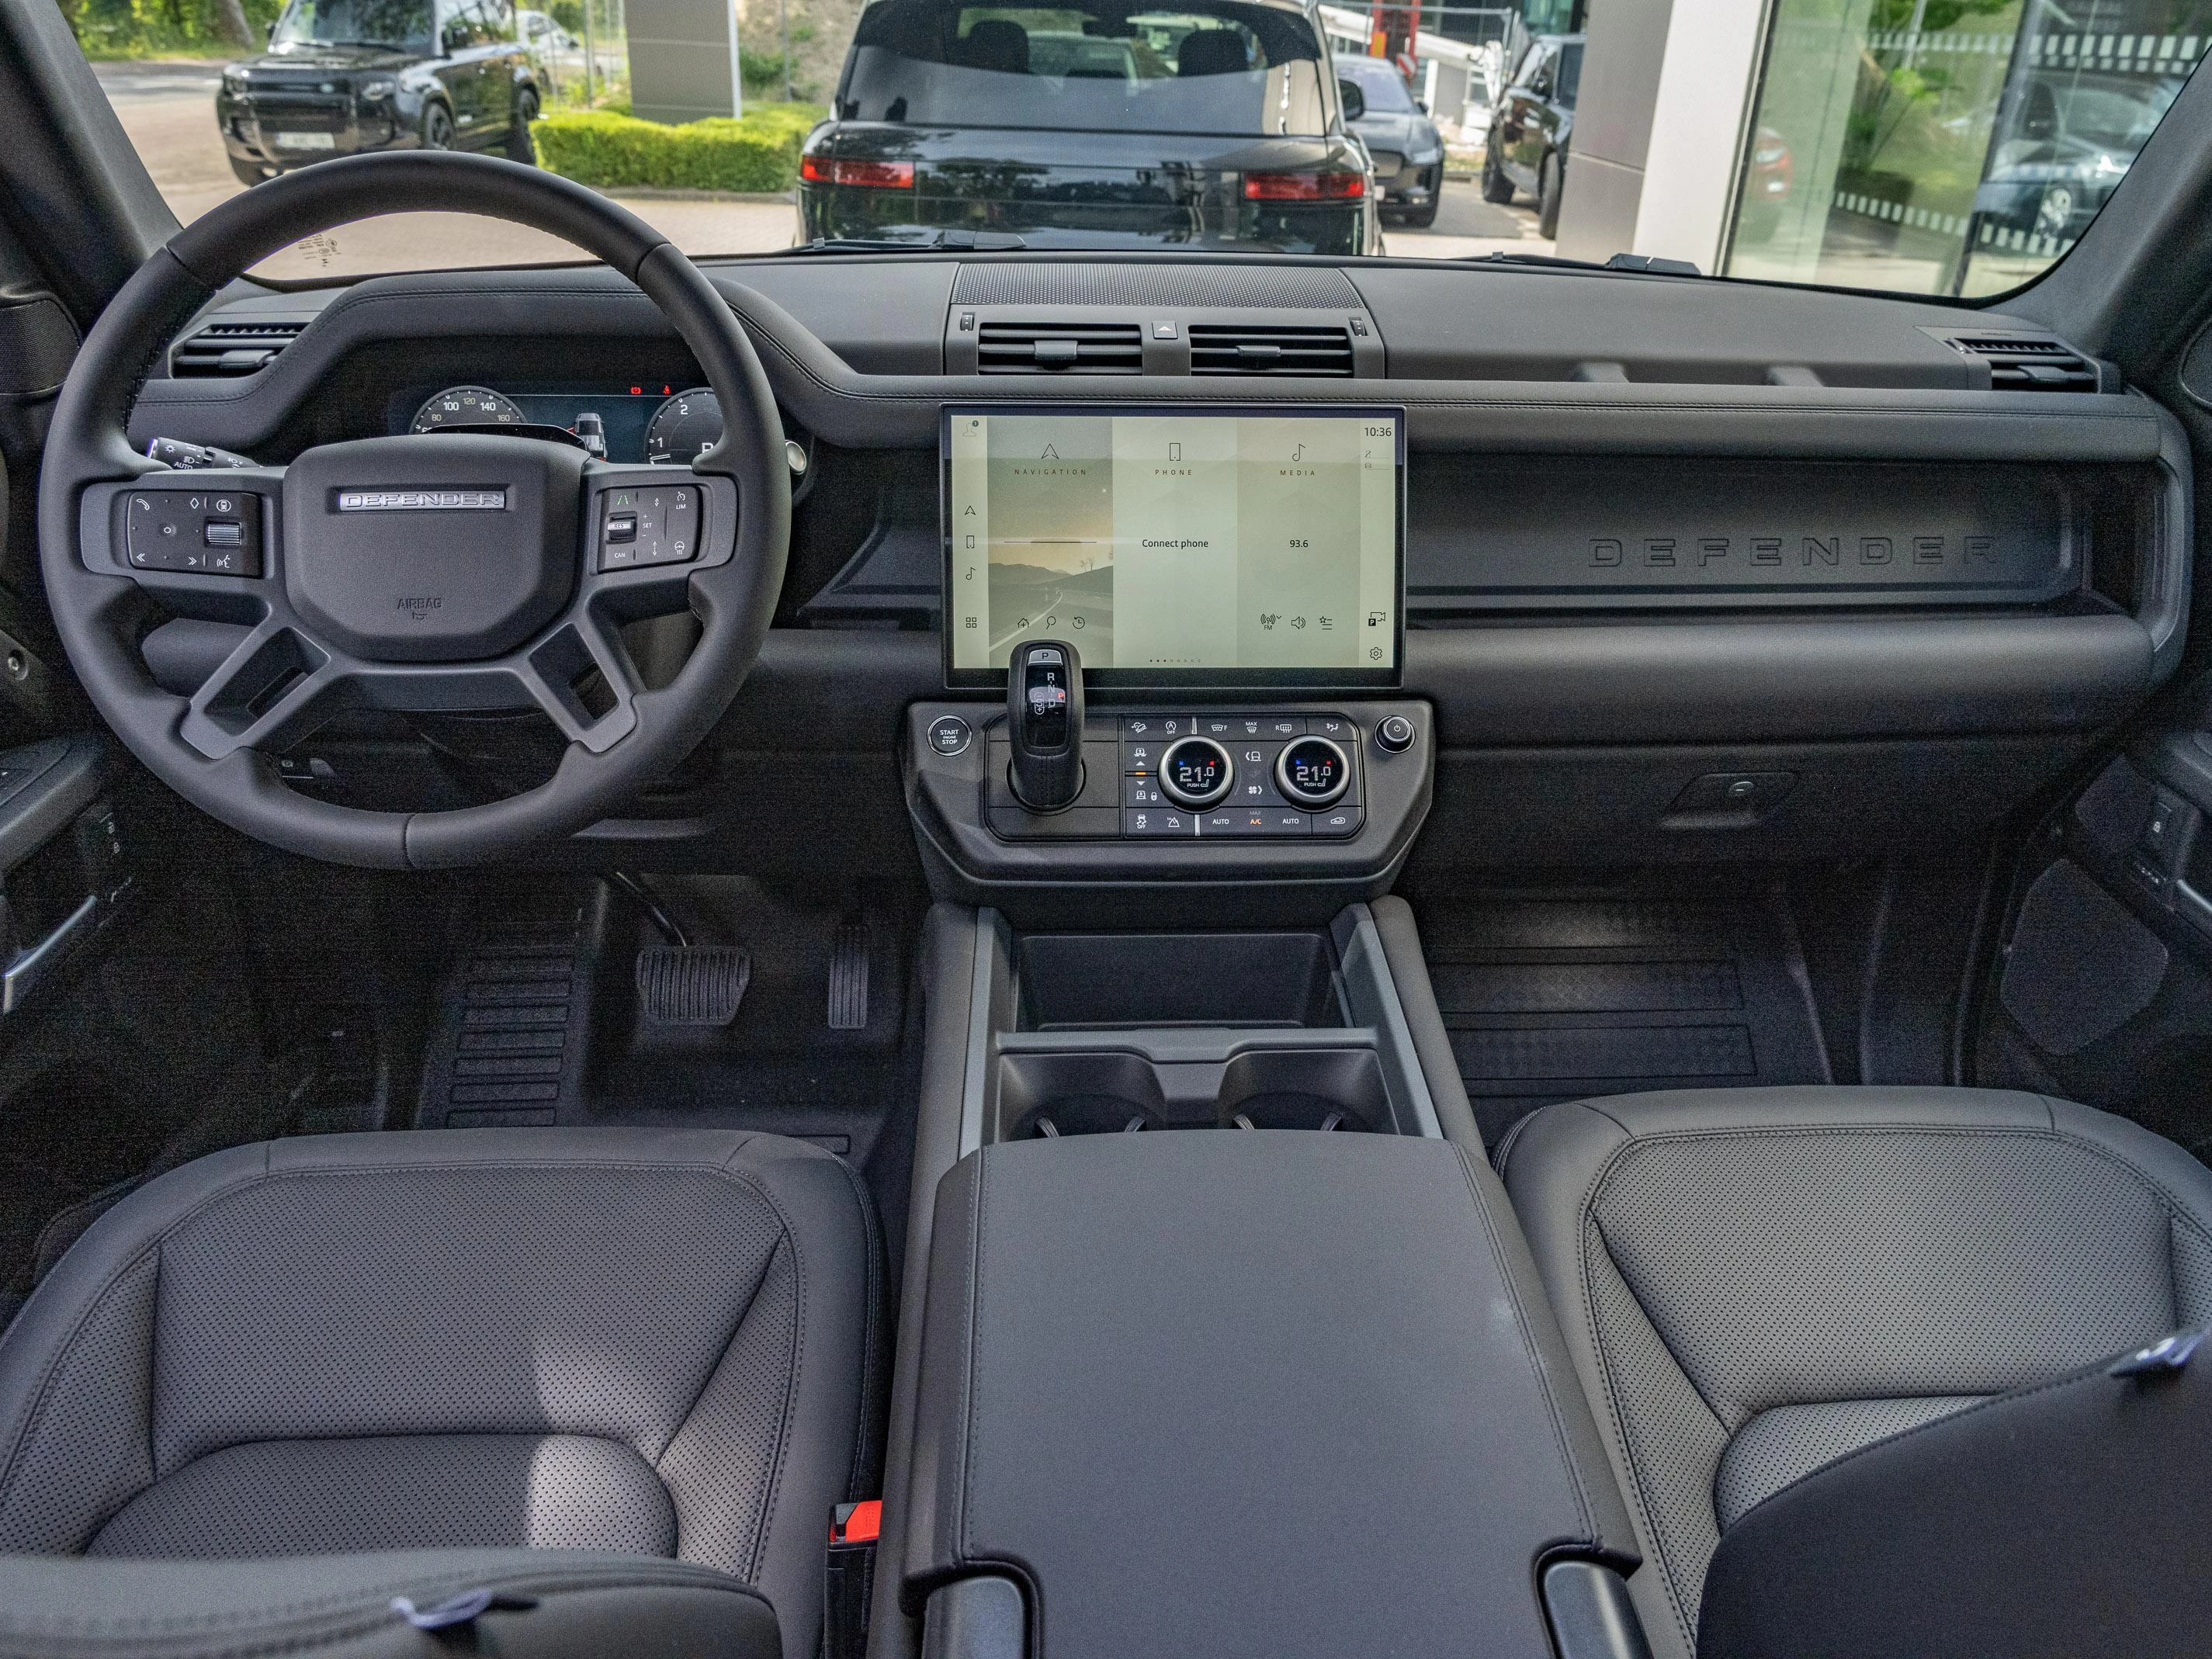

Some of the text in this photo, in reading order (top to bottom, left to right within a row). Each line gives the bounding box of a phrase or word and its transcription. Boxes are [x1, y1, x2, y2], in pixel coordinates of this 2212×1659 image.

[443, 402, 459, 411] 100
[480, 402, 496, 411] 140
[680, 404, 688, 415] 2
[1364, 427, 1392, 437] 10:36
[657, 437, 663, 448] 1
[174, 461, 193, 469] AUTO
[346, 493, 501, 508] DEFENDER
[1142, 539, 1208, 549] Connect phone
[1289, 539, 1309, 548] 93.6
[1589, 536, 1997, 567] DEFENDER
[397, 597, 443, 609] AIRBAG
[1047, 672, 1055, 681] R
[1048, 684, 1056, 693] N
[1048, 698, 1056, 707] D
[1180, 767, 1215, 782] 21.0
[1296, 766, 1331, 781] 21.0
